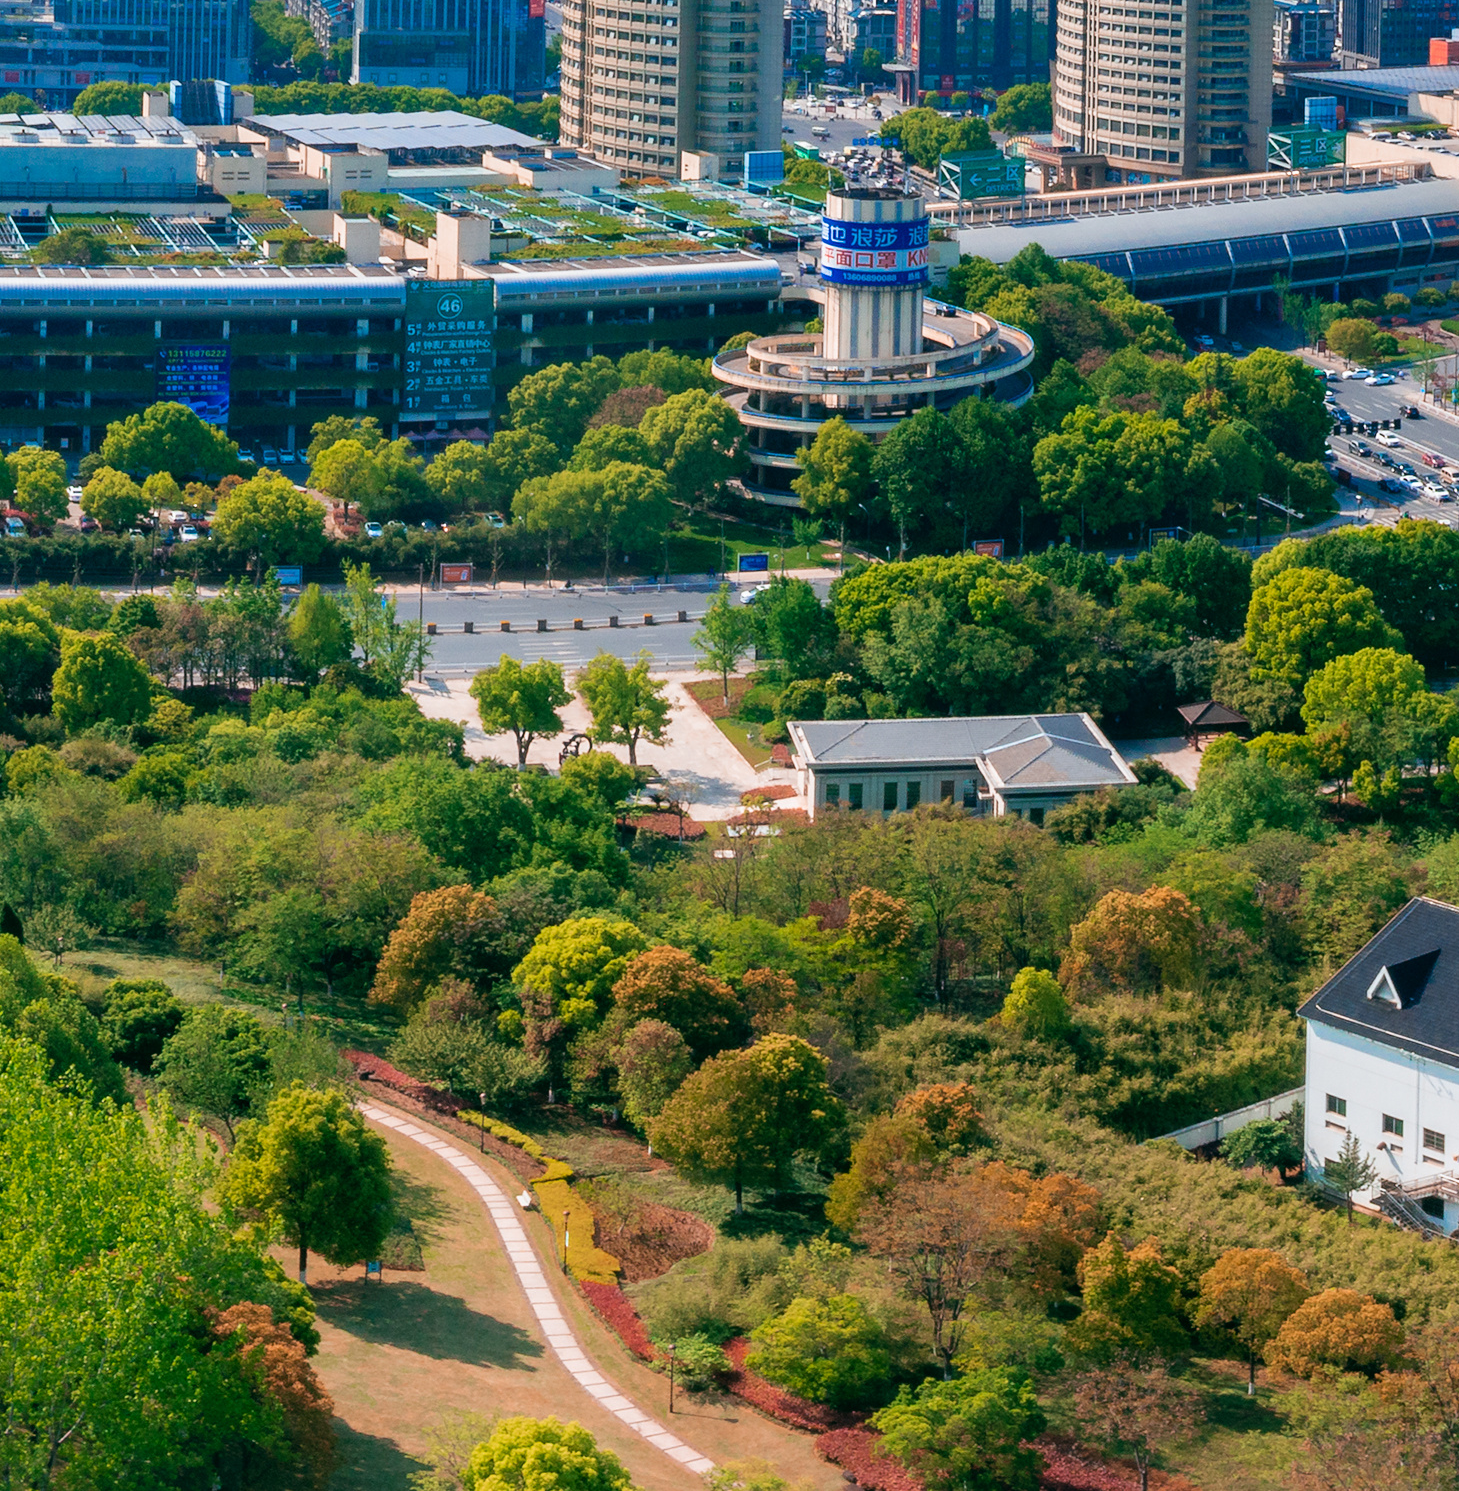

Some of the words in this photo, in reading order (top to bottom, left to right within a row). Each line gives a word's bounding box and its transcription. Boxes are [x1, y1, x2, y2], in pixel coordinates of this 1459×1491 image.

[1299, 138, 1328, 155] 三区
[986, 165, 1021, 182] 二区
[851, 227, 898, 247] 浪莎
[825, 247, 897, 269] 平面口罩
[440, 298, 461, 313] 46
[427, 320, 486, 332] 外贸采购服务
